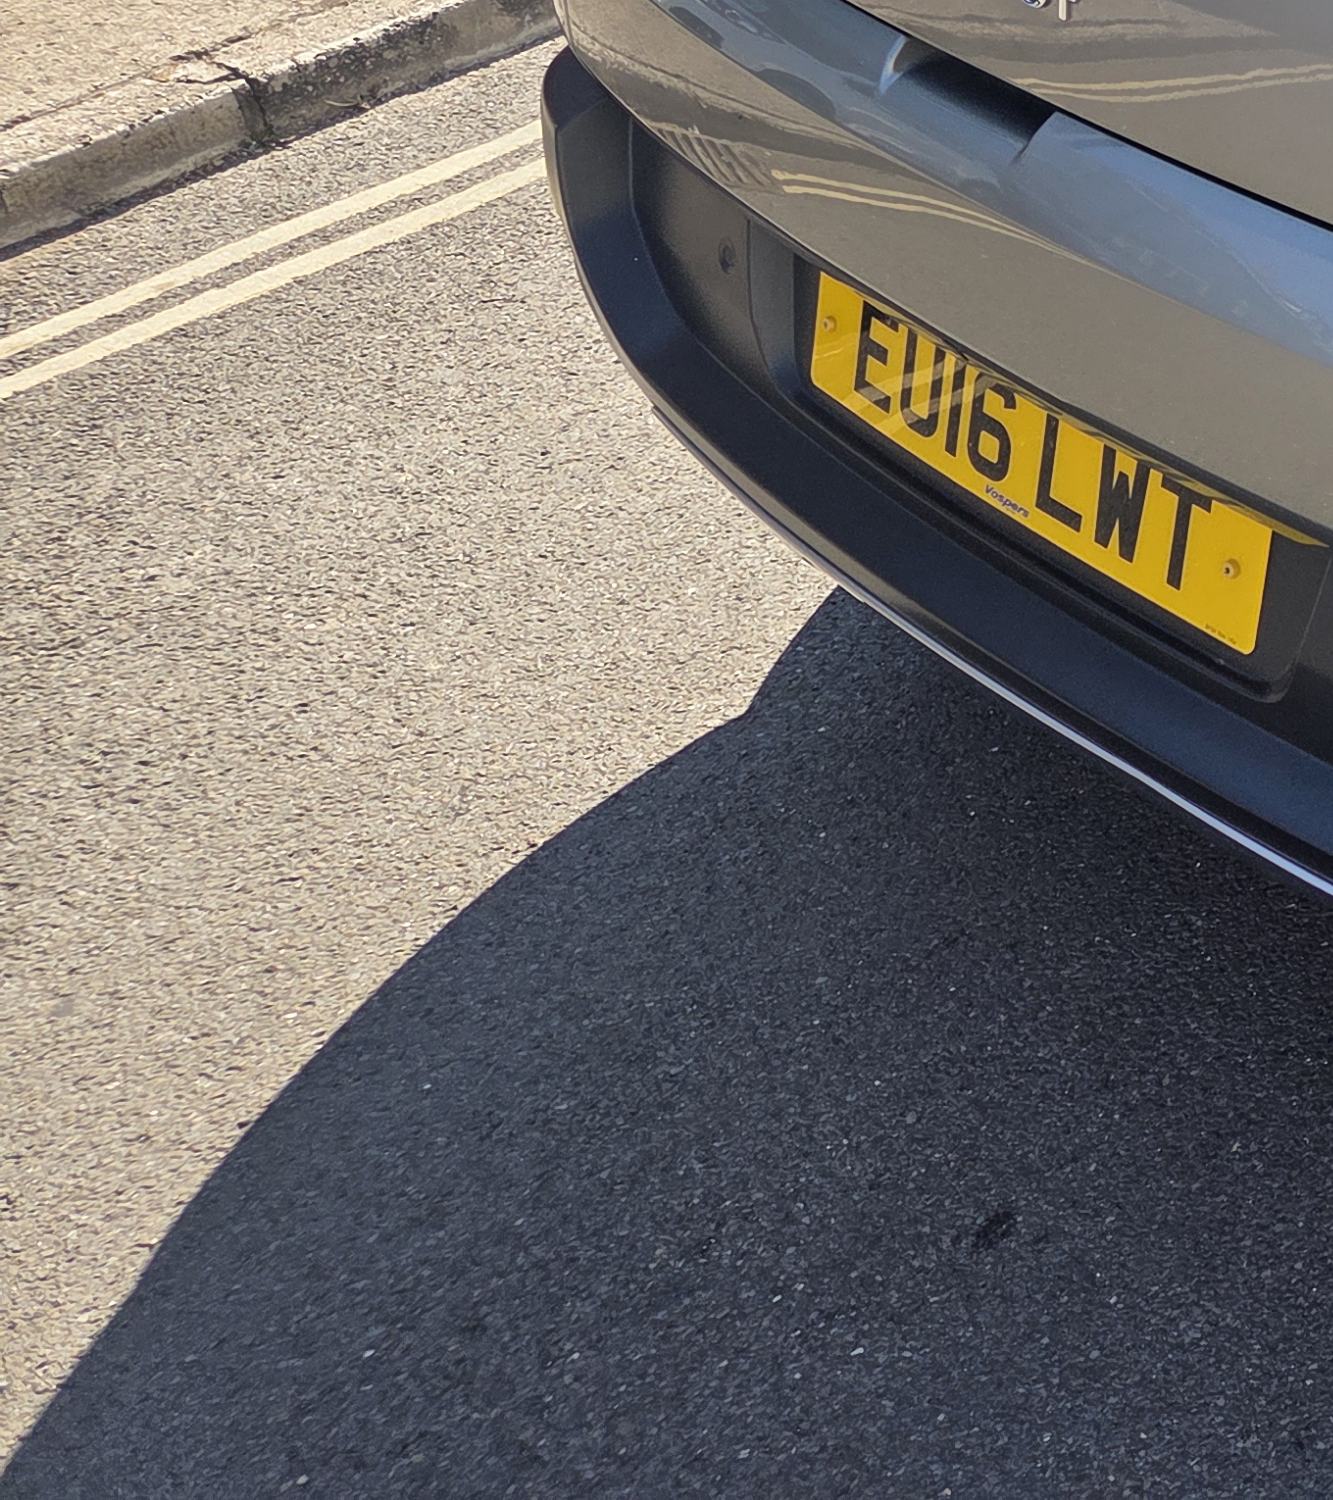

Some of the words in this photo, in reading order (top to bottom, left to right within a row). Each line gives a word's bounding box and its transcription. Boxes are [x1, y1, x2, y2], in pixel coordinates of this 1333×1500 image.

[853, 299, 1017, 483] EU16
[1034, 411, 1213, 591] LWT
[985, 484, 1030, 518] Vospers
